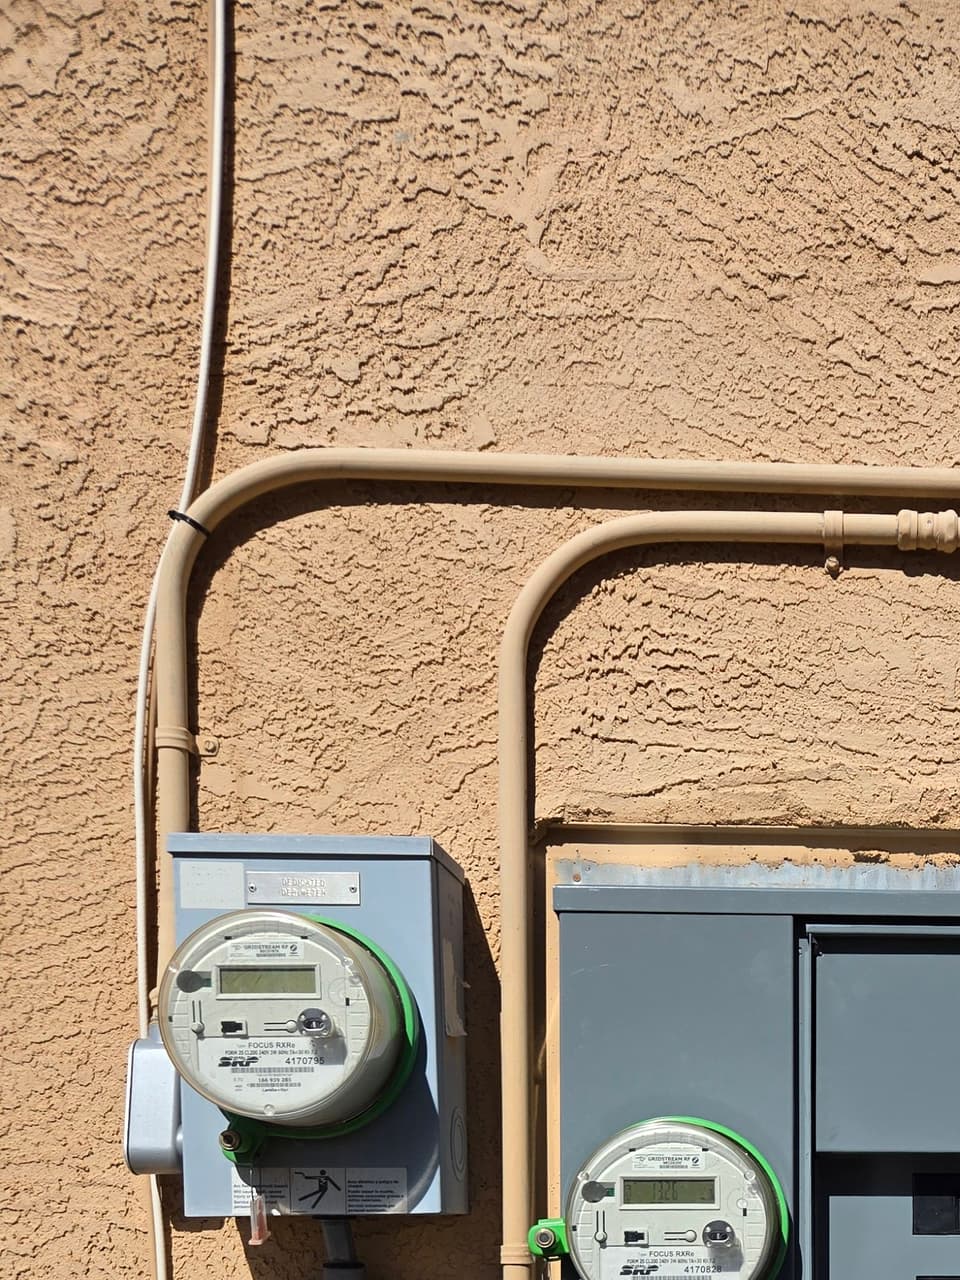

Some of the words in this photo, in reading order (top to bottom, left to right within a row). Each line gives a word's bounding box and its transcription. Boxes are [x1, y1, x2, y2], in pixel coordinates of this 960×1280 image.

[218, 1056, 259, 1067] SRP
[285, 1057, 325, 1065] 4170795
[619, 1264, 659, 1275] SRP
[684, 1265, 722, 1273] 4170828
